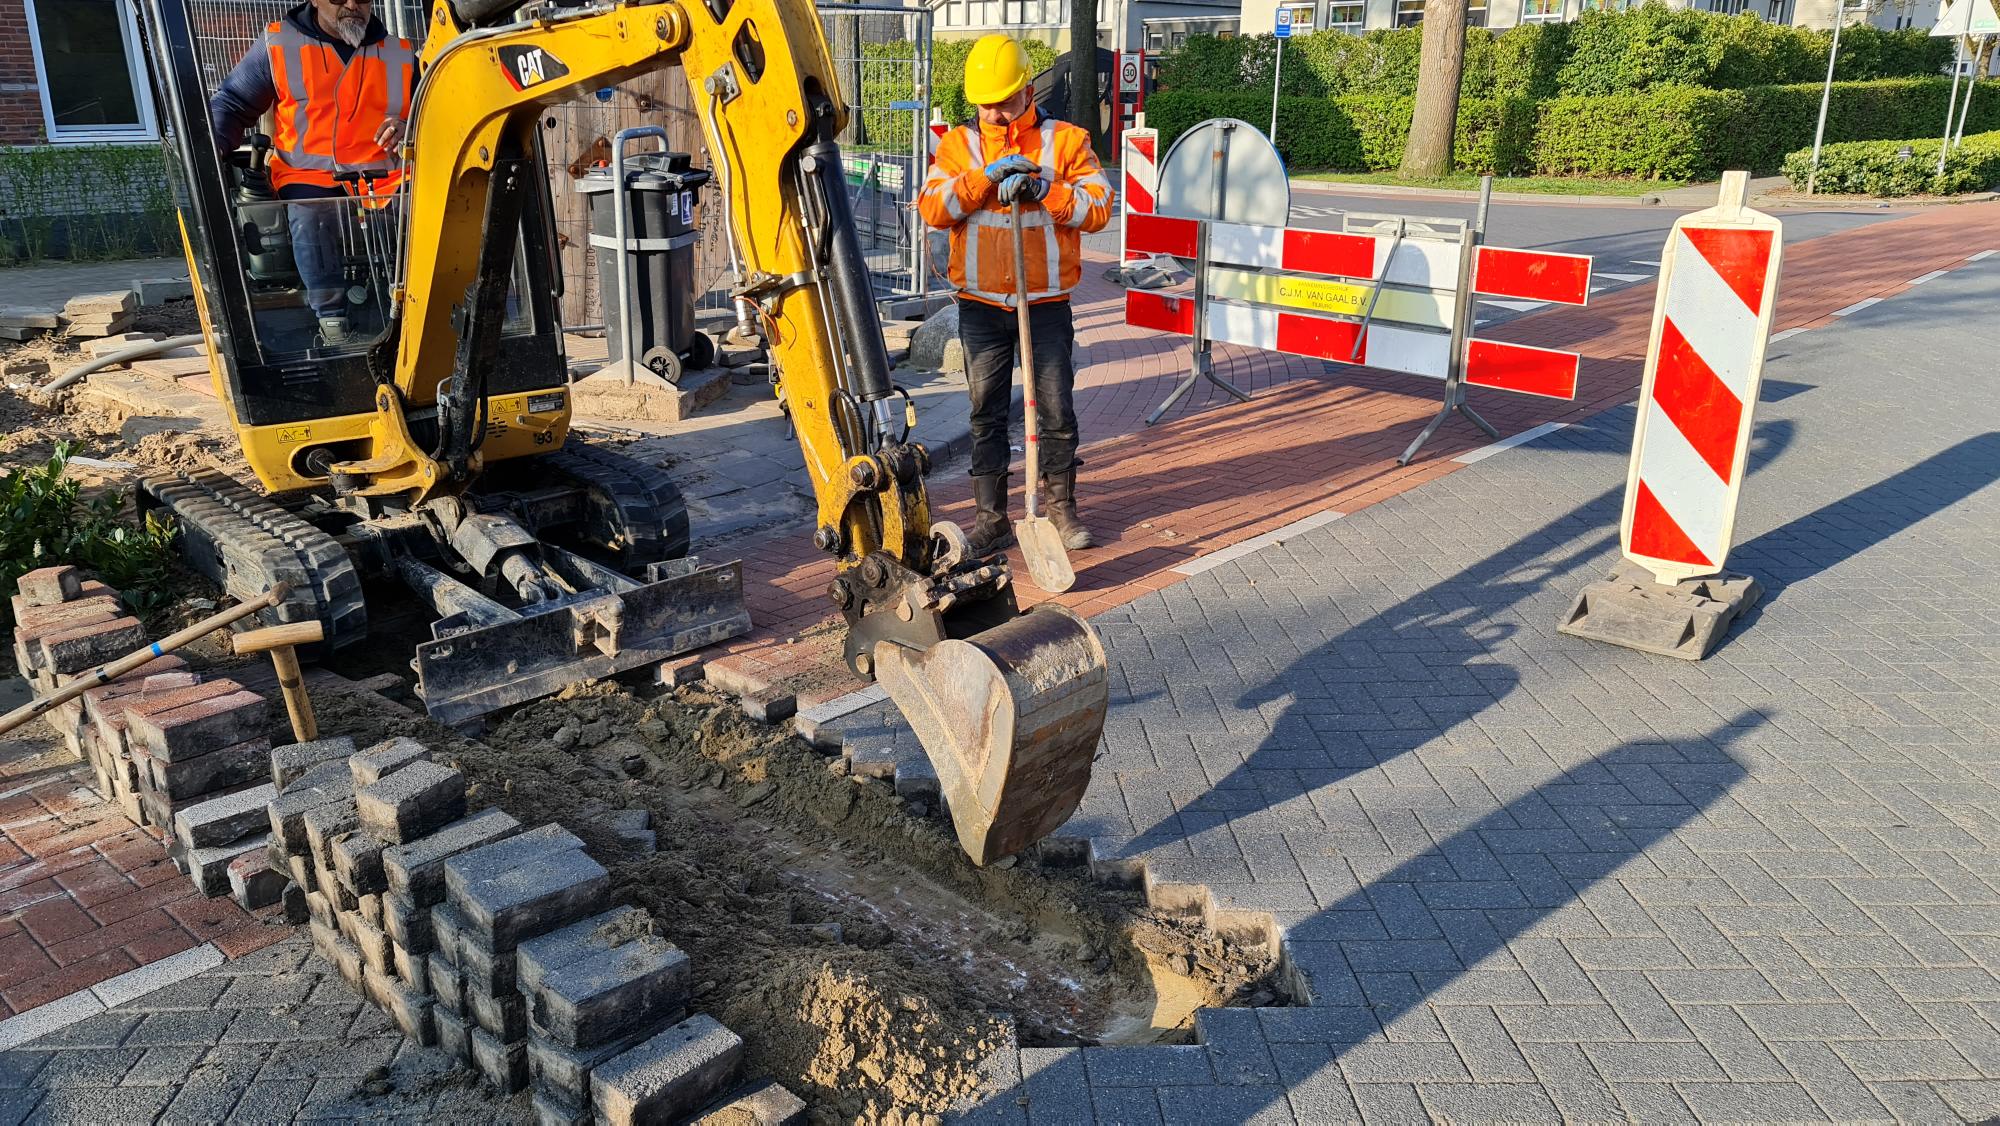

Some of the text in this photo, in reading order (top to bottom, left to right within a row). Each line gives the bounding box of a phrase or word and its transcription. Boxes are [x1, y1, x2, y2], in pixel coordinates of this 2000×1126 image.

[517, 48, 545, 87] CAT
[1125, 69, 1135, 77] 30
[1306, 290, 1323, 301] VAN
[1325, 292, 1349, 304] GAAL
[1351, 295, 1367, 307] B.V.
